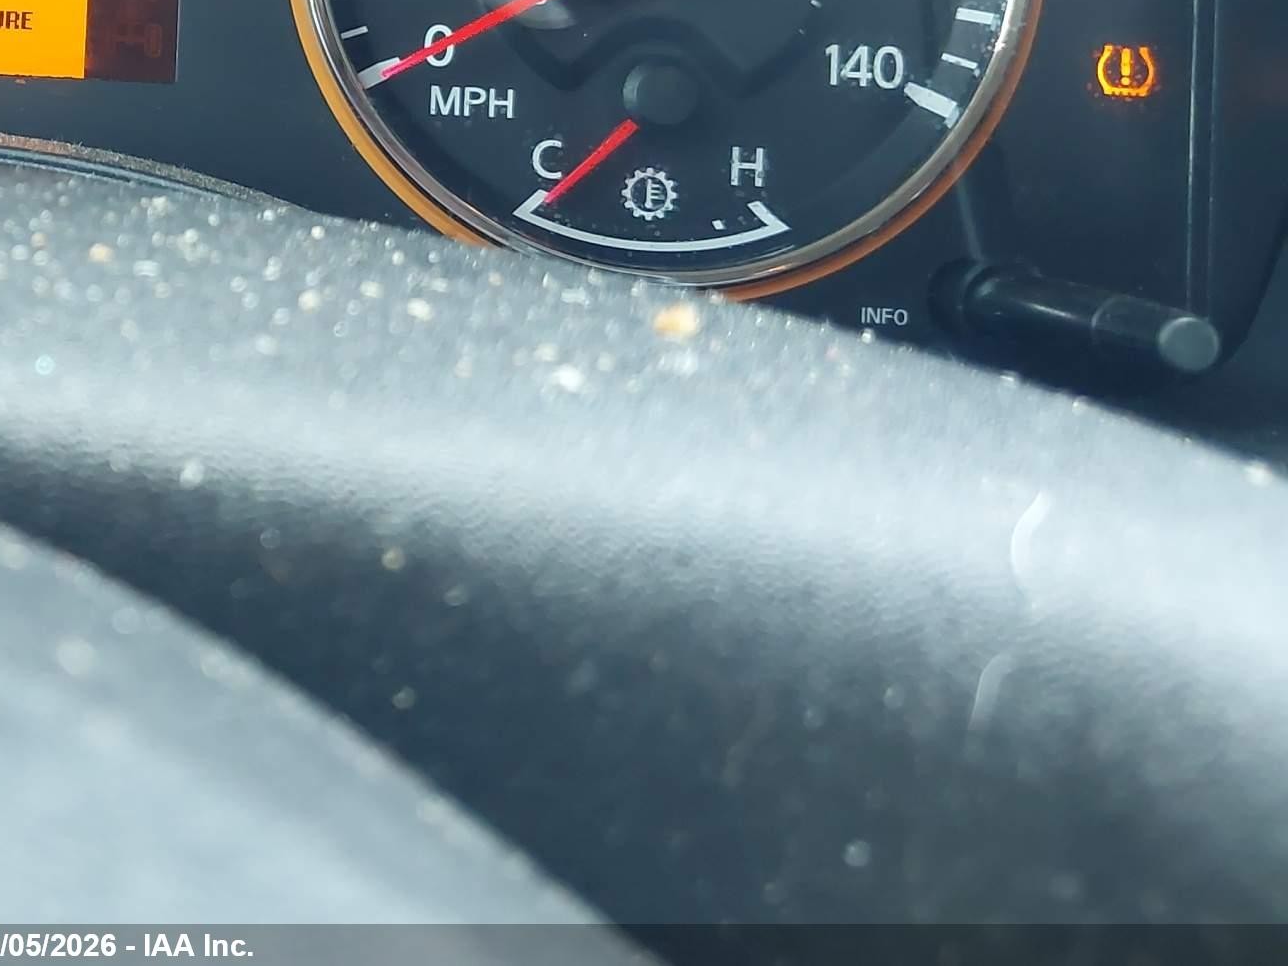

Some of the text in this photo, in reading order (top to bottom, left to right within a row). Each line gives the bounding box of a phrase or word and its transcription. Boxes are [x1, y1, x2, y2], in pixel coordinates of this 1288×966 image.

[424, 24, 455, 67] 0
[825, 43, 904, 90] 140
[429, 85, 516, 119] MPH
[530, 139, 565, 181] C
[729, 146, 767, 187] H
[860, 307, 909, 326] INFO
